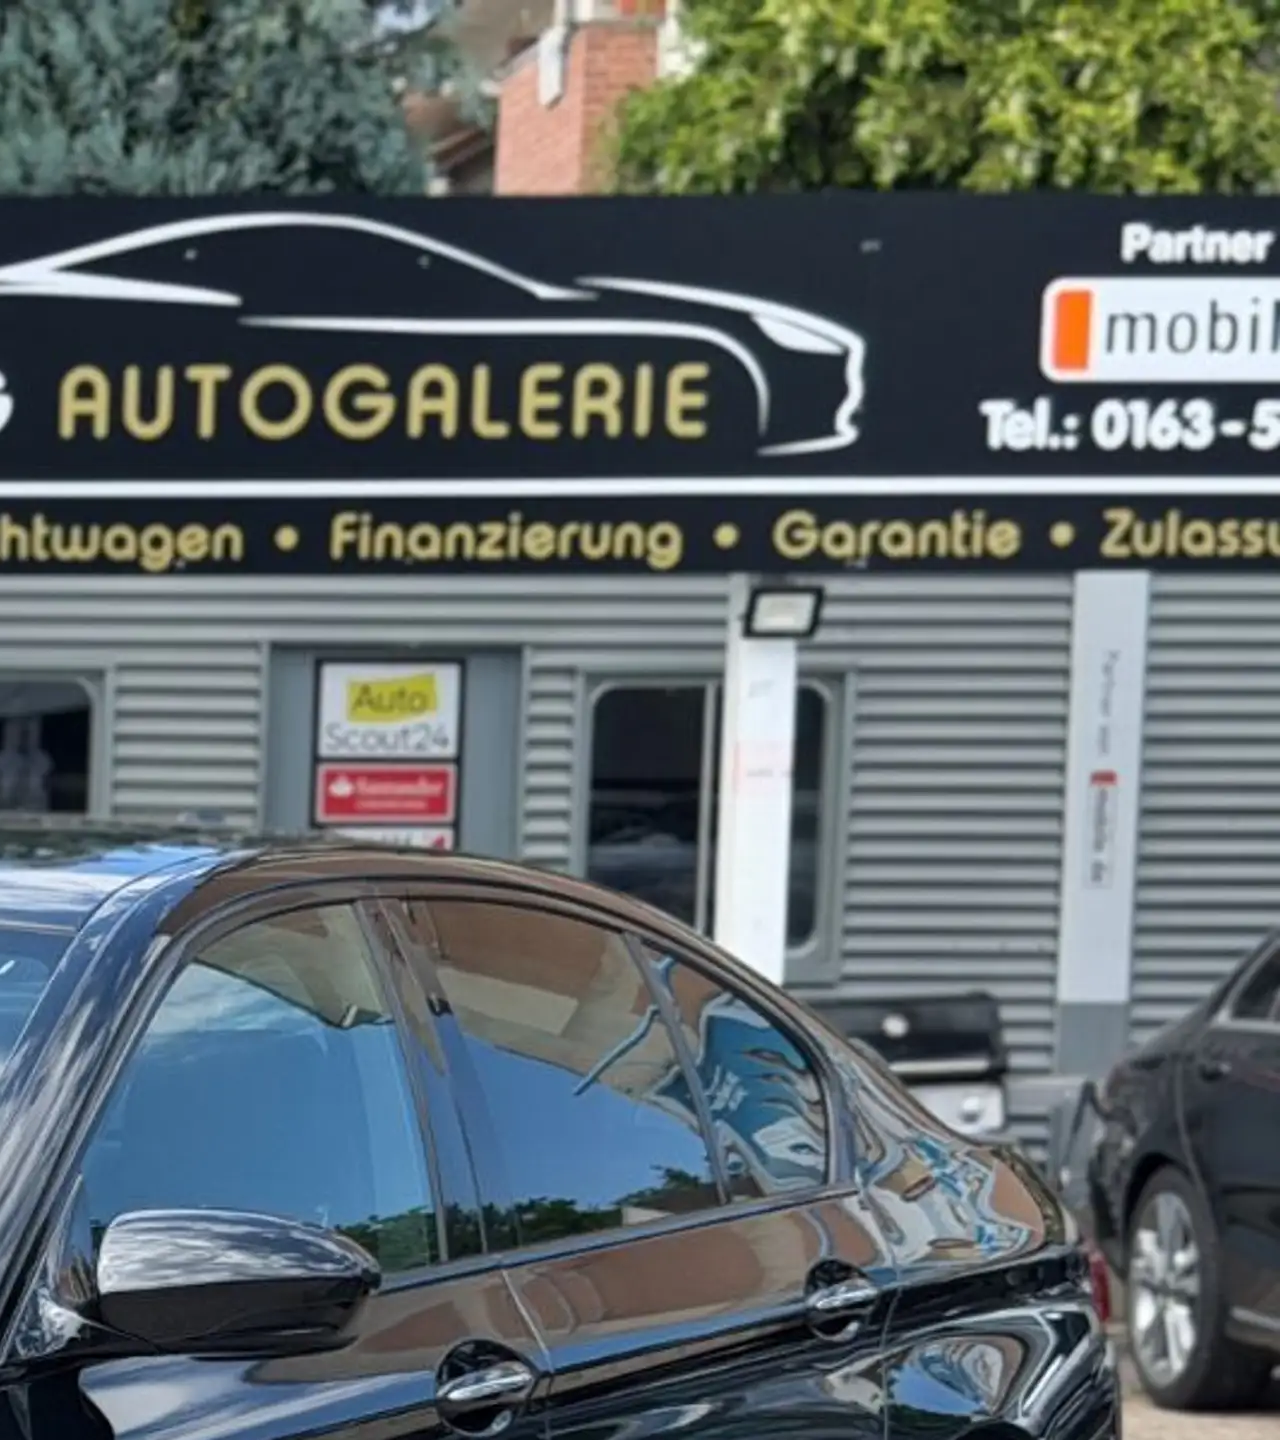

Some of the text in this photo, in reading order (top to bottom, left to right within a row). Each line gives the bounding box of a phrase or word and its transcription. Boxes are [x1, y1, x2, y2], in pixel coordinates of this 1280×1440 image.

[1120, 221, 1276, 265] Partner
[58, 363, 710, 440] AUTOGALERIE
[979, 396, 1080, 452] Tel.:
[329, 512, 683, 570] Finanzierung
[772, 510, 1022, 559] Garantie
[351, 683, 429, 714] Auto
[324, 722, 451, 752] Scout24
